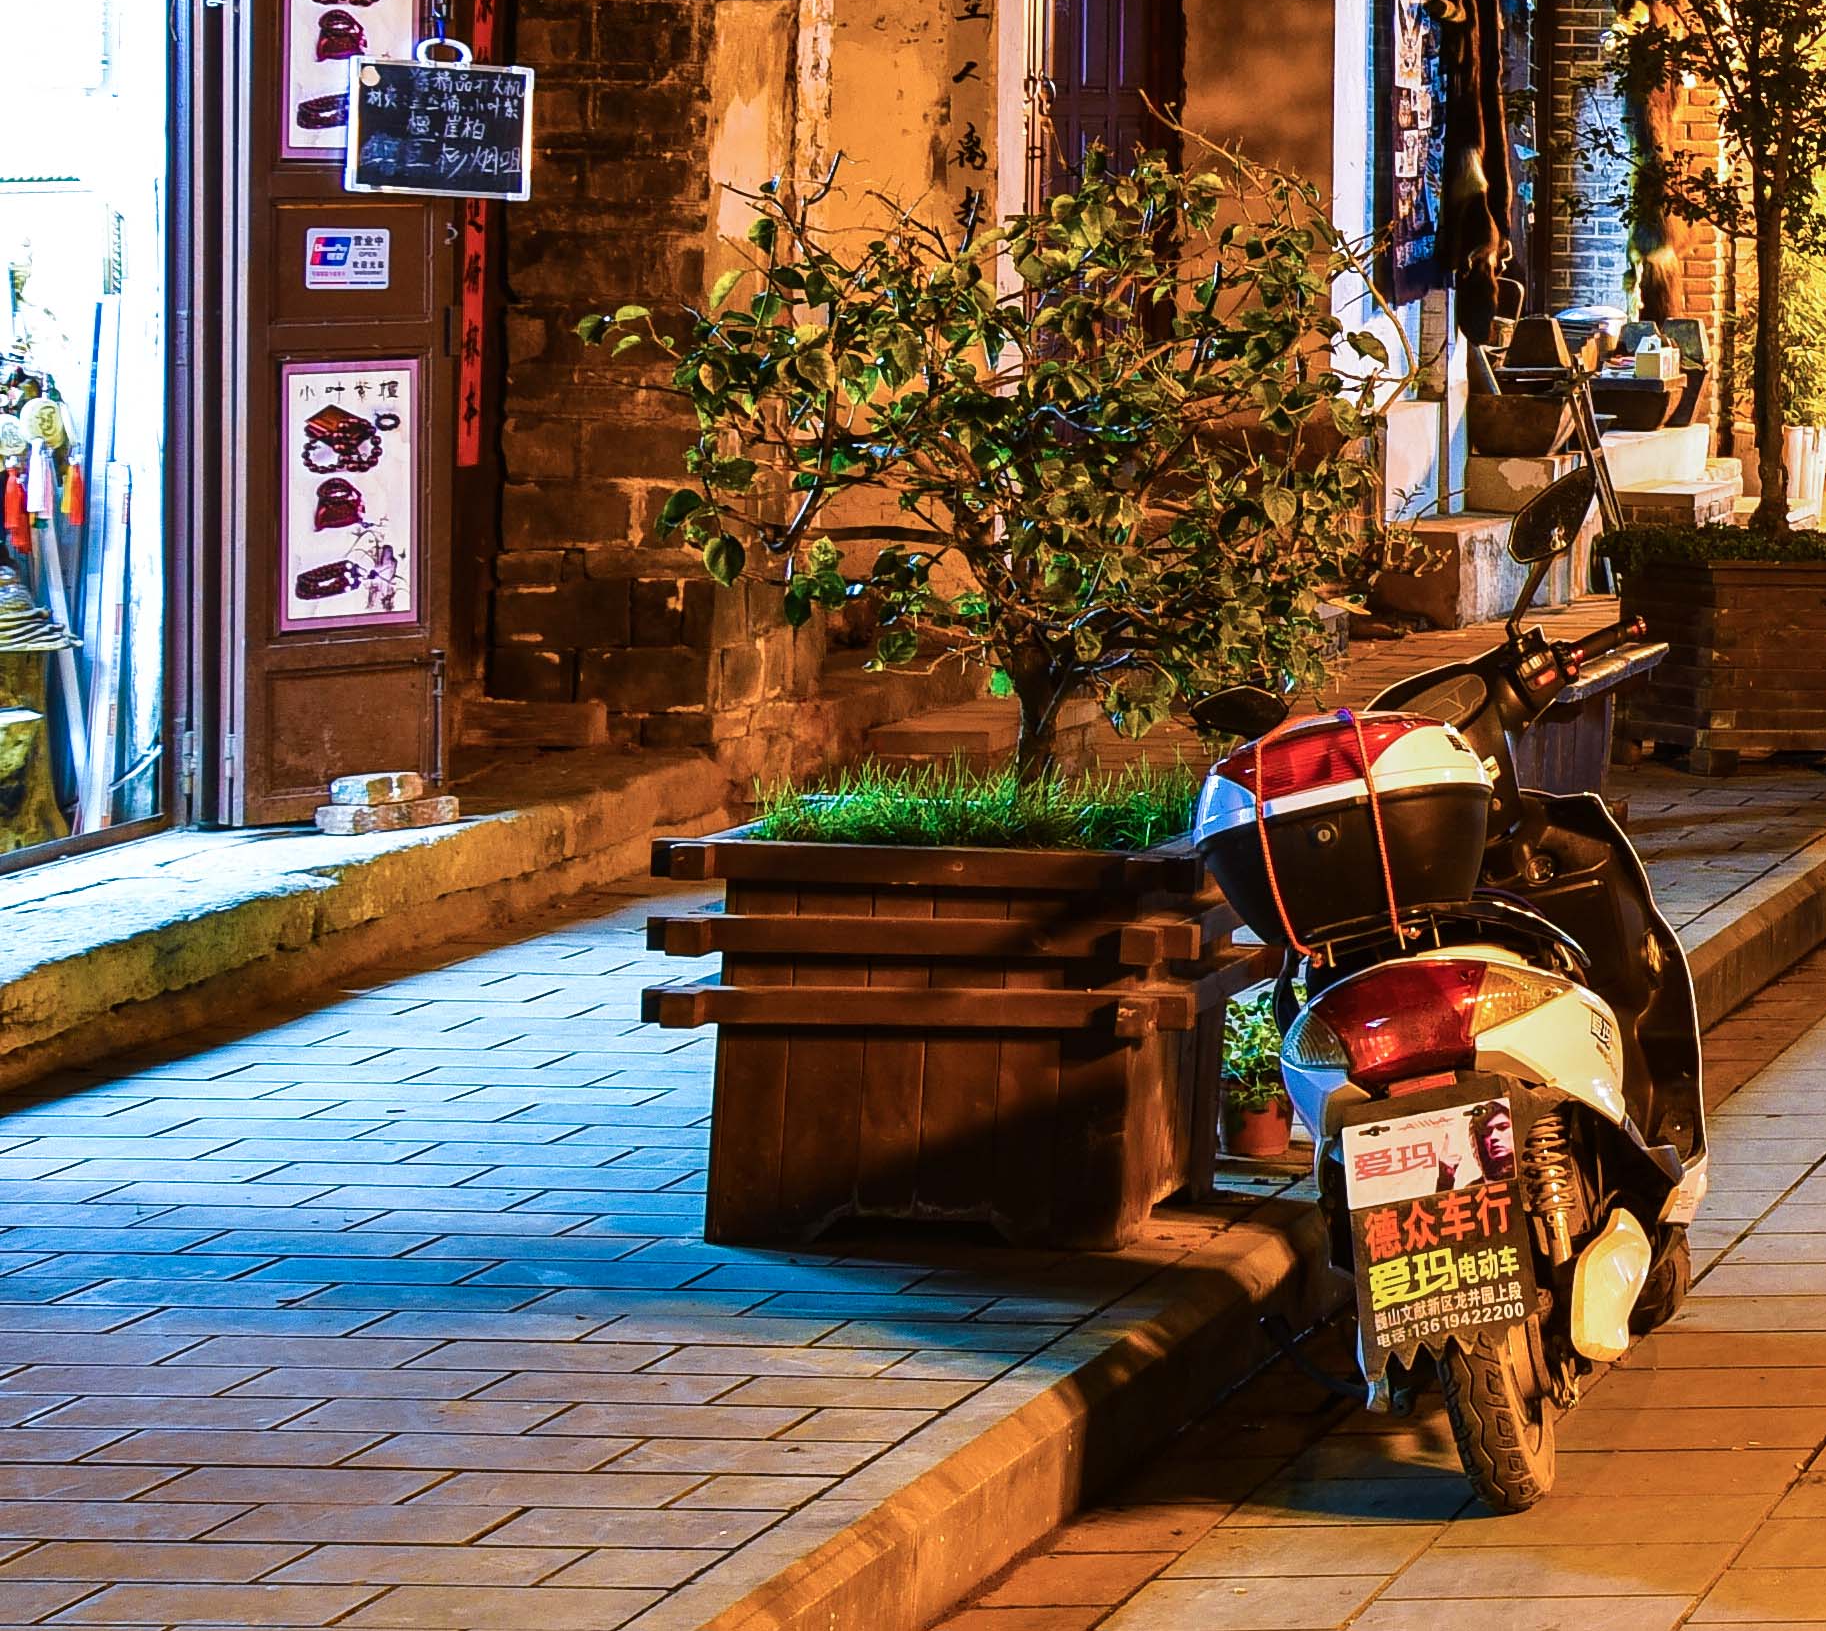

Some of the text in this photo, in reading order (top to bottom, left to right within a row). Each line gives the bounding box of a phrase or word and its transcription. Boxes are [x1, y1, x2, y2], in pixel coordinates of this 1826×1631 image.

[1353, 1140, 1437, 1182] 爱玛
[1364, 1183, 1513, 1263] 德众车行
